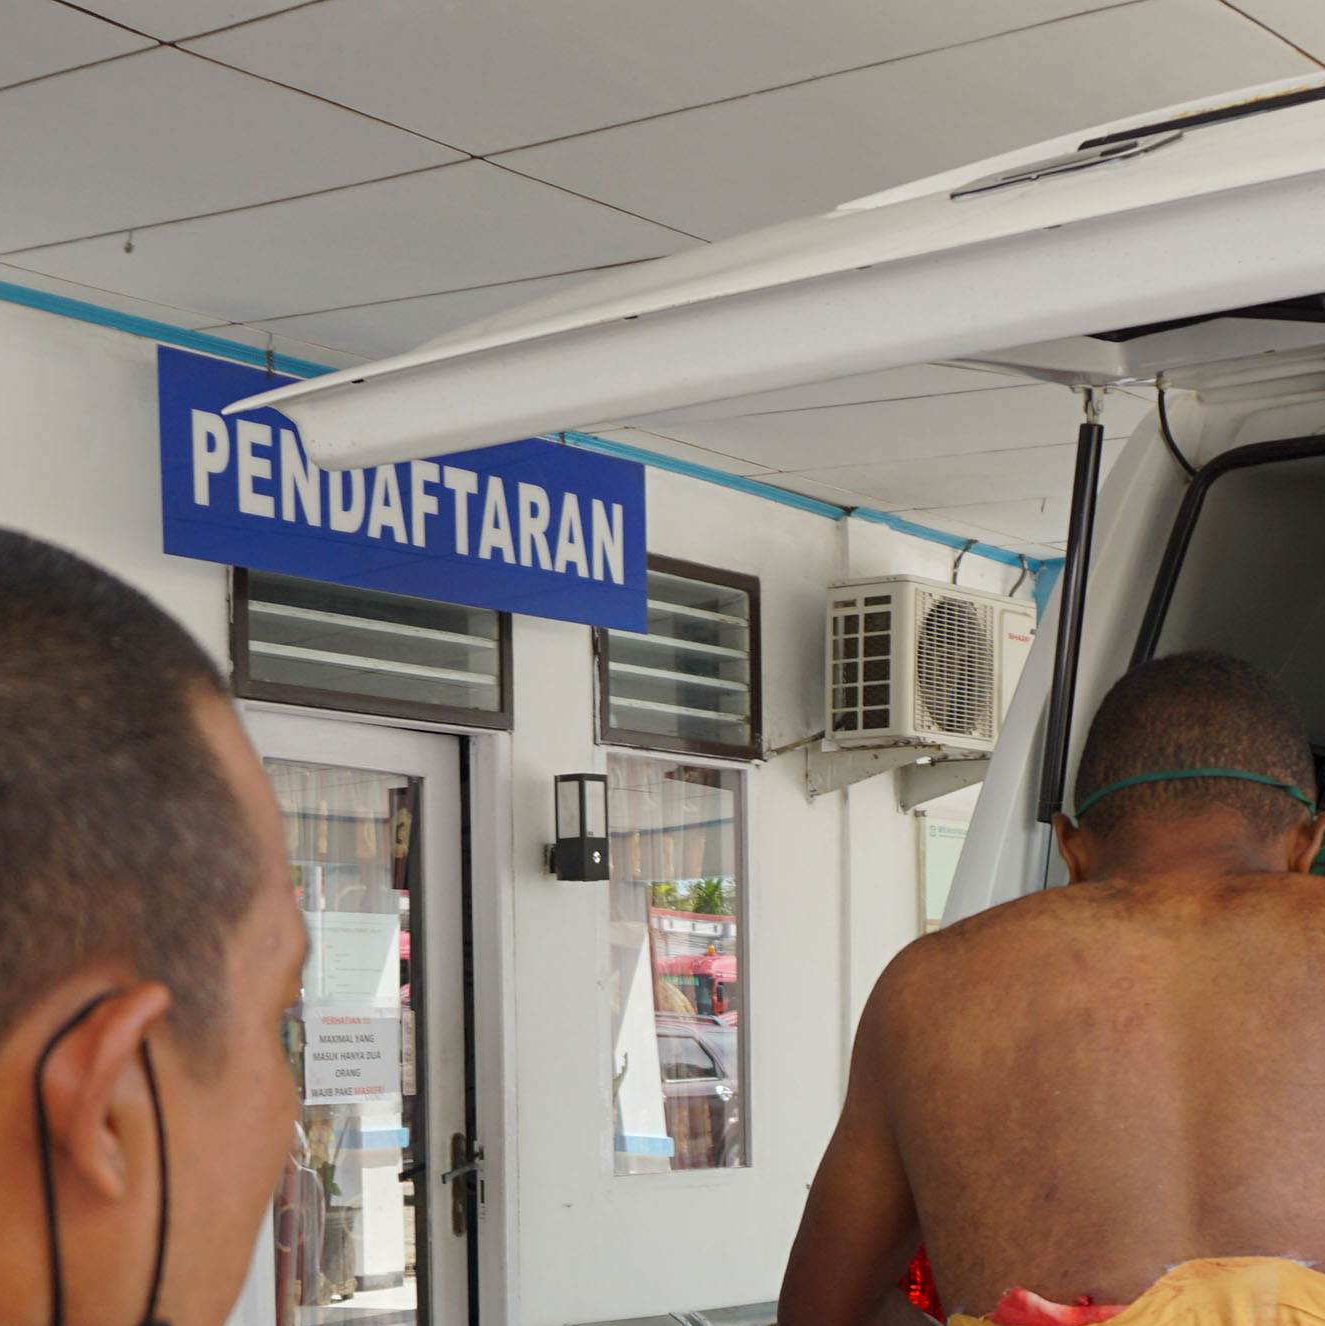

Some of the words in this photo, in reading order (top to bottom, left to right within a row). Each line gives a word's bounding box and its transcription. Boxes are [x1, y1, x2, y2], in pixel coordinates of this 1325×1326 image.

[191, 408, 626, 585] PENDAFTARAN
[355, 1033, 375, 1043] YANG
[313, 1052, 339, 1061] MASUK
[340, 1051, 364, 1060] HANYA
[366, 1051, 382, 1060] DUA
[335, 1068, 362, 1078] ORANG
[311, 1087, 334, 1097] WAJIB
[334, 1087, 354, 1097] PAKE
